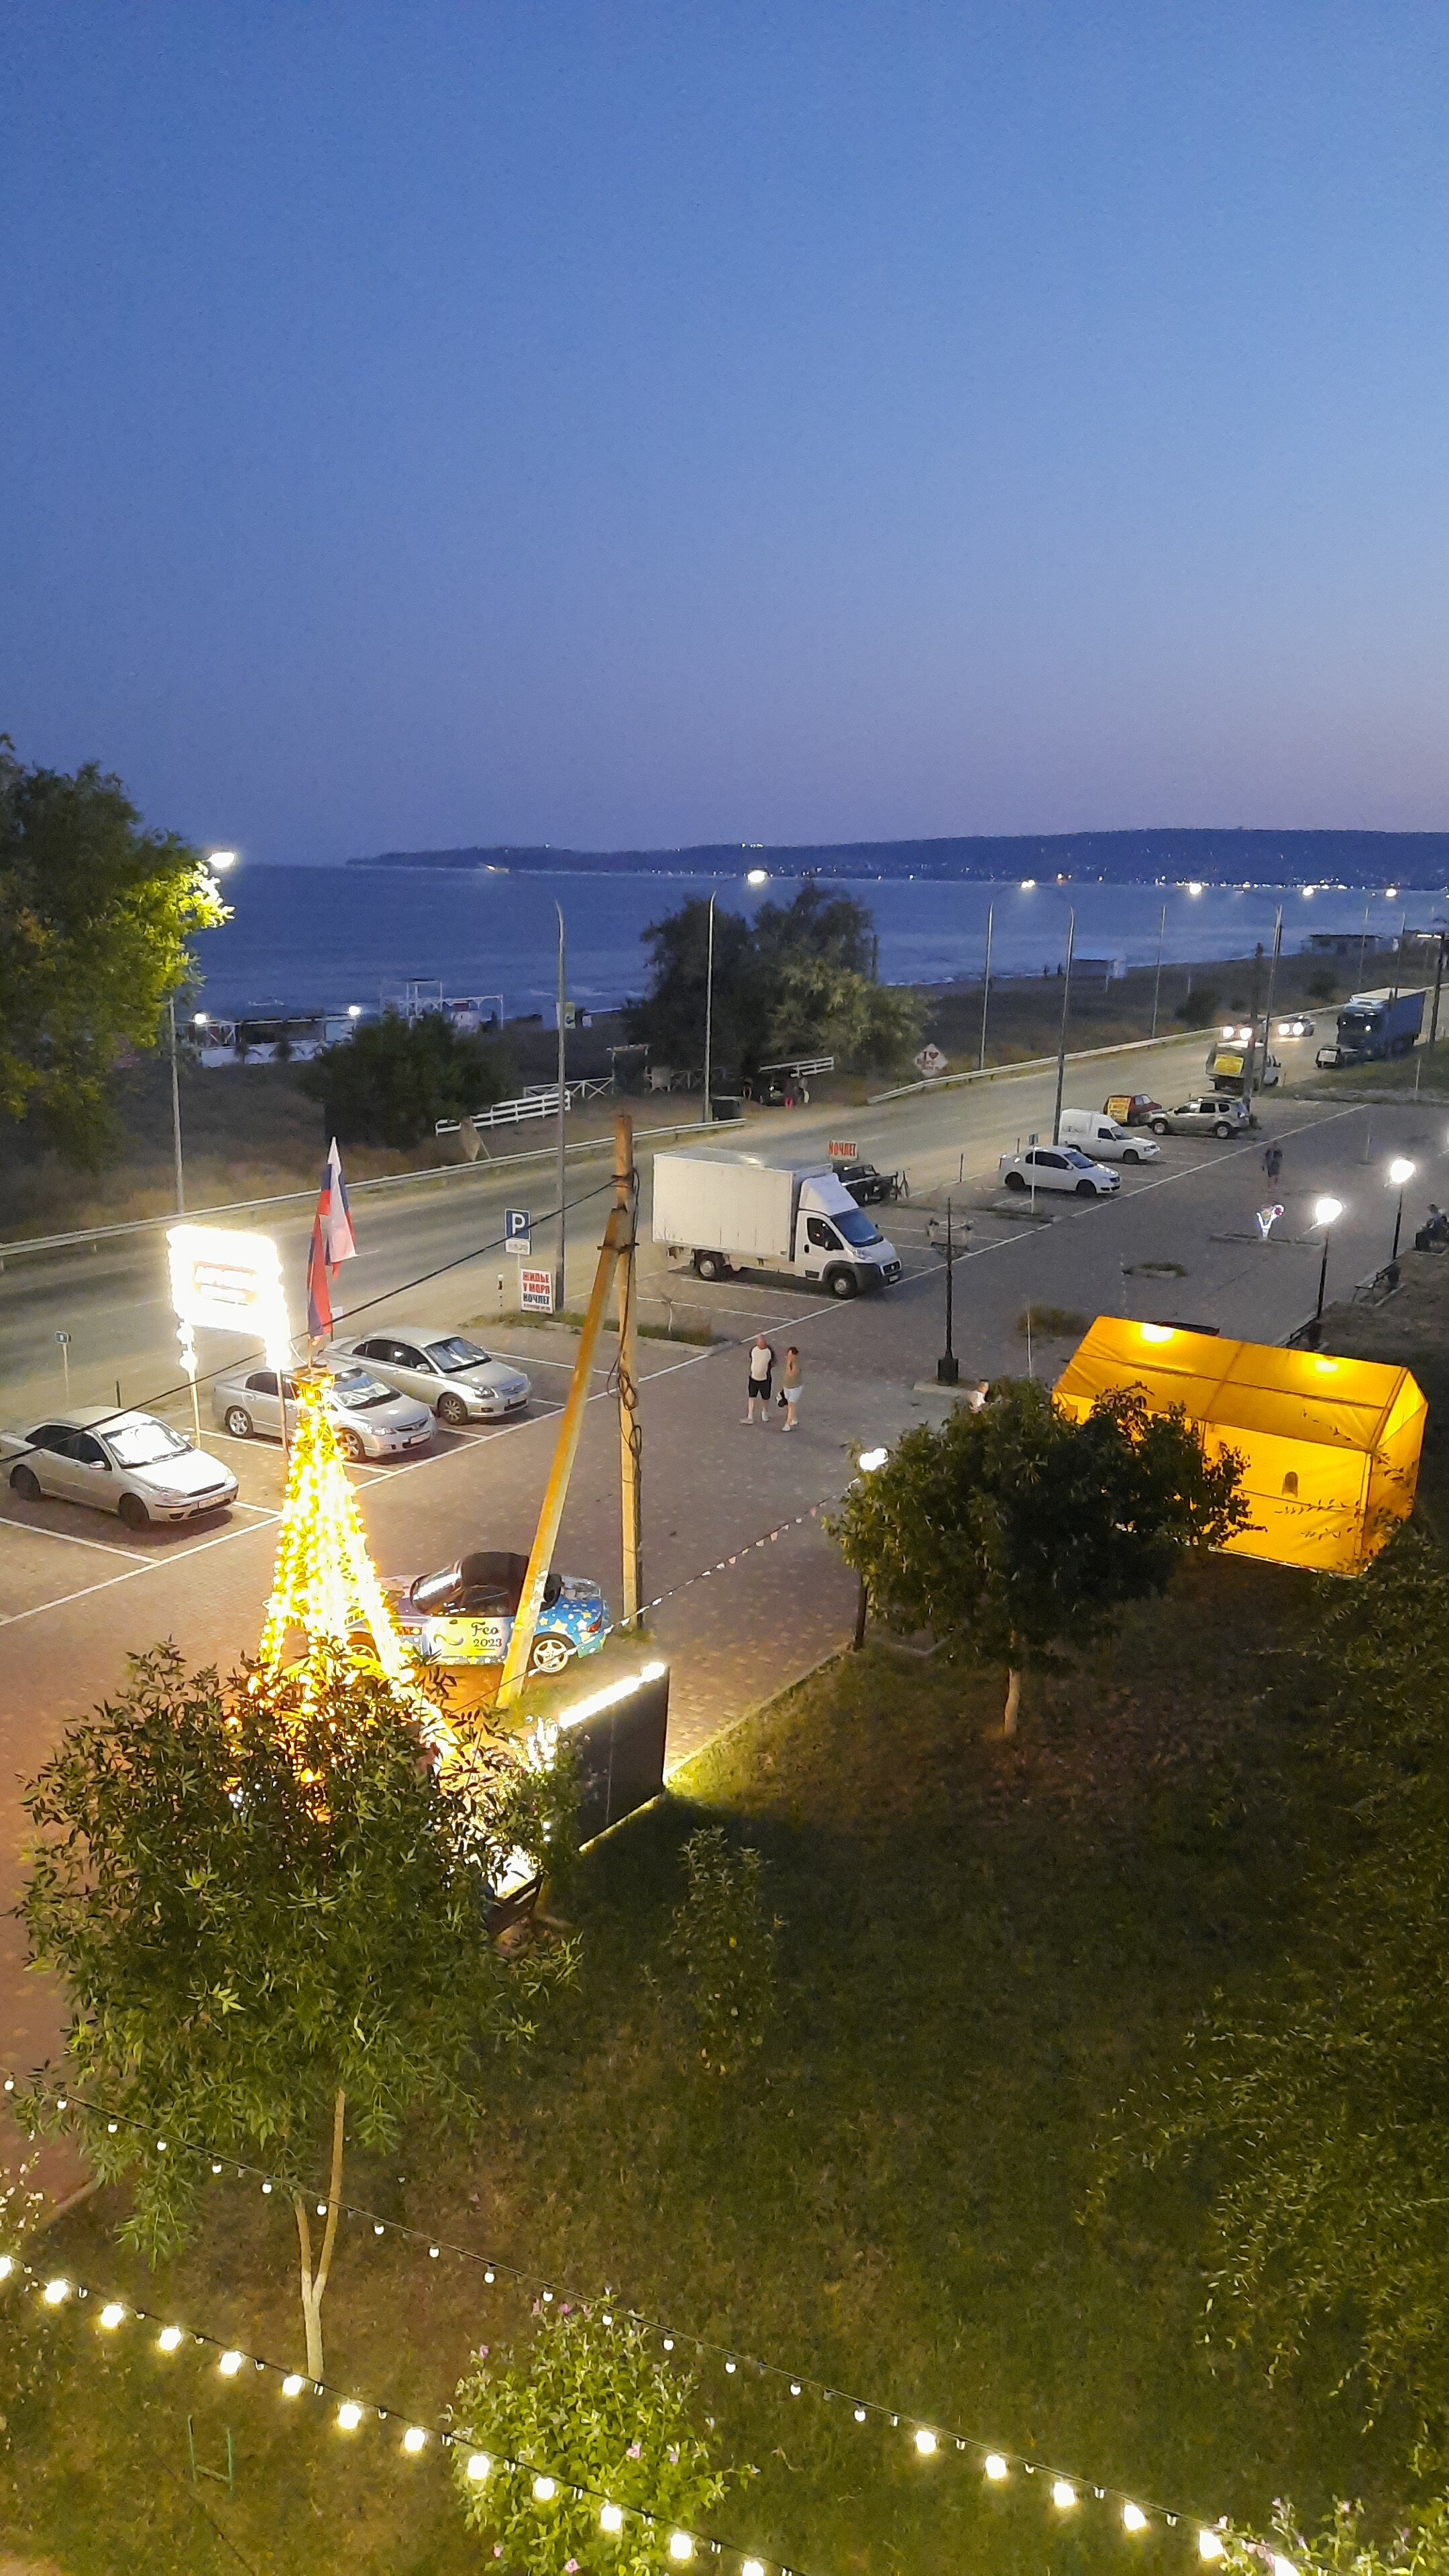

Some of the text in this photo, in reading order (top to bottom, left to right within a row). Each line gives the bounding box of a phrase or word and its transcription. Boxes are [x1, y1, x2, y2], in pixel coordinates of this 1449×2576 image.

[512, 1213, 525, 1236] P
[523, 1293, 549, 1305] НОЧЛЕГ
[473, 1638, 502, 1647] 2023
